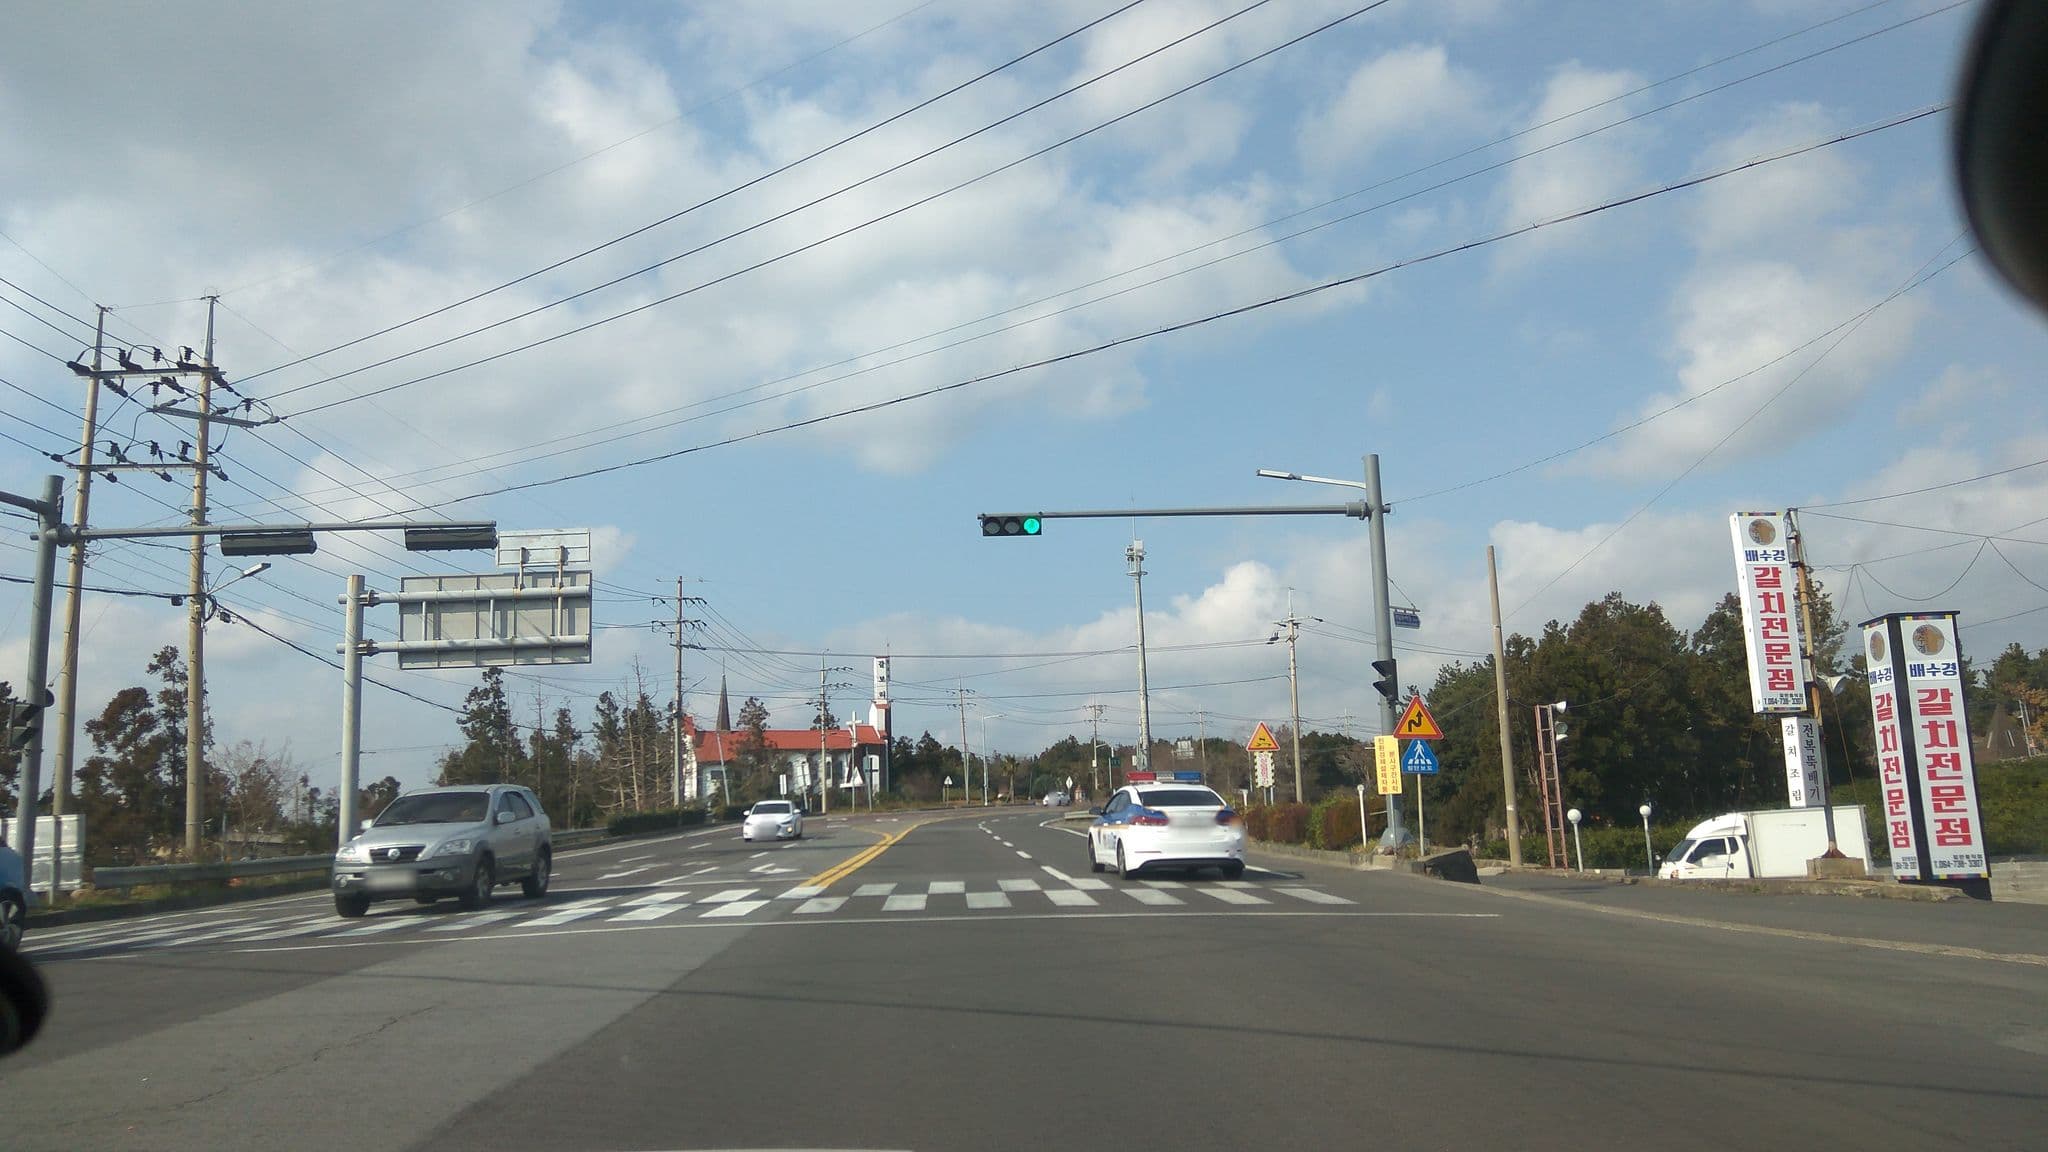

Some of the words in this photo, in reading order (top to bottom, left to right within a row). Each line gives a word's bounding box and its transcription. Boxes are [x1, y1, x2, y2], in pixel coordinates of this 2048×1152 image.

[1745, 549, 1786, 562] 배수경
[1754, 567, 1795, 691] 갈치전문점
[1869, 667, 1893, 685] 배수경
[1910, 662, 1958, 678] 배수경
[1785, 724, 1802, 802] 갈치조림
[1802, 723, 1820, 800] 전복뚝배기
[1875, 692, 1911, 848] 갈치전문점
[1917, 688, 1973, 846] 갈치전문점
